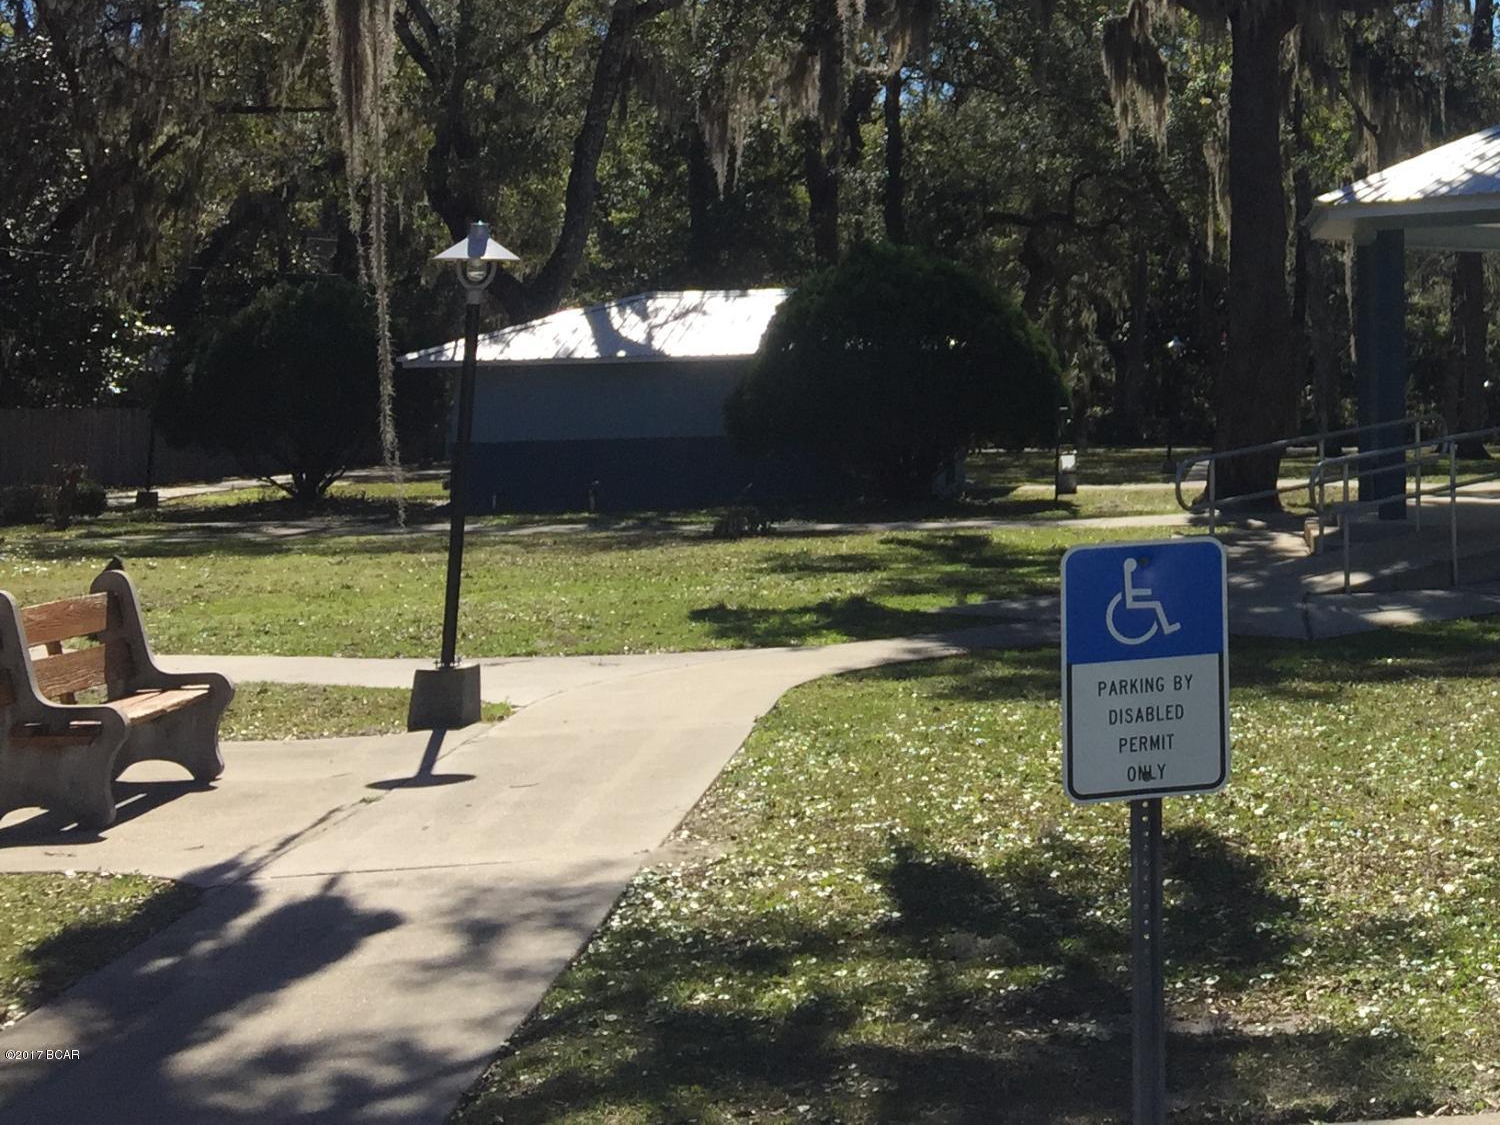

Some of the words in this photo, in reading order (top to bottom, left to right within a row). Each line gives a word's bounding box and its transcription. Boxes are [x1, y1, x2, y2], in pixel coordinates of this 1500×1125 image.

[1098, 676, 1165, 696] PARKING
[1173, 674, 1193, 691] BY
[1109, 704, 1184, 725] DISABLED
[1119, 734, 1175, 753] PERMIT
[1127, 763, 1166, 782] ONLY
